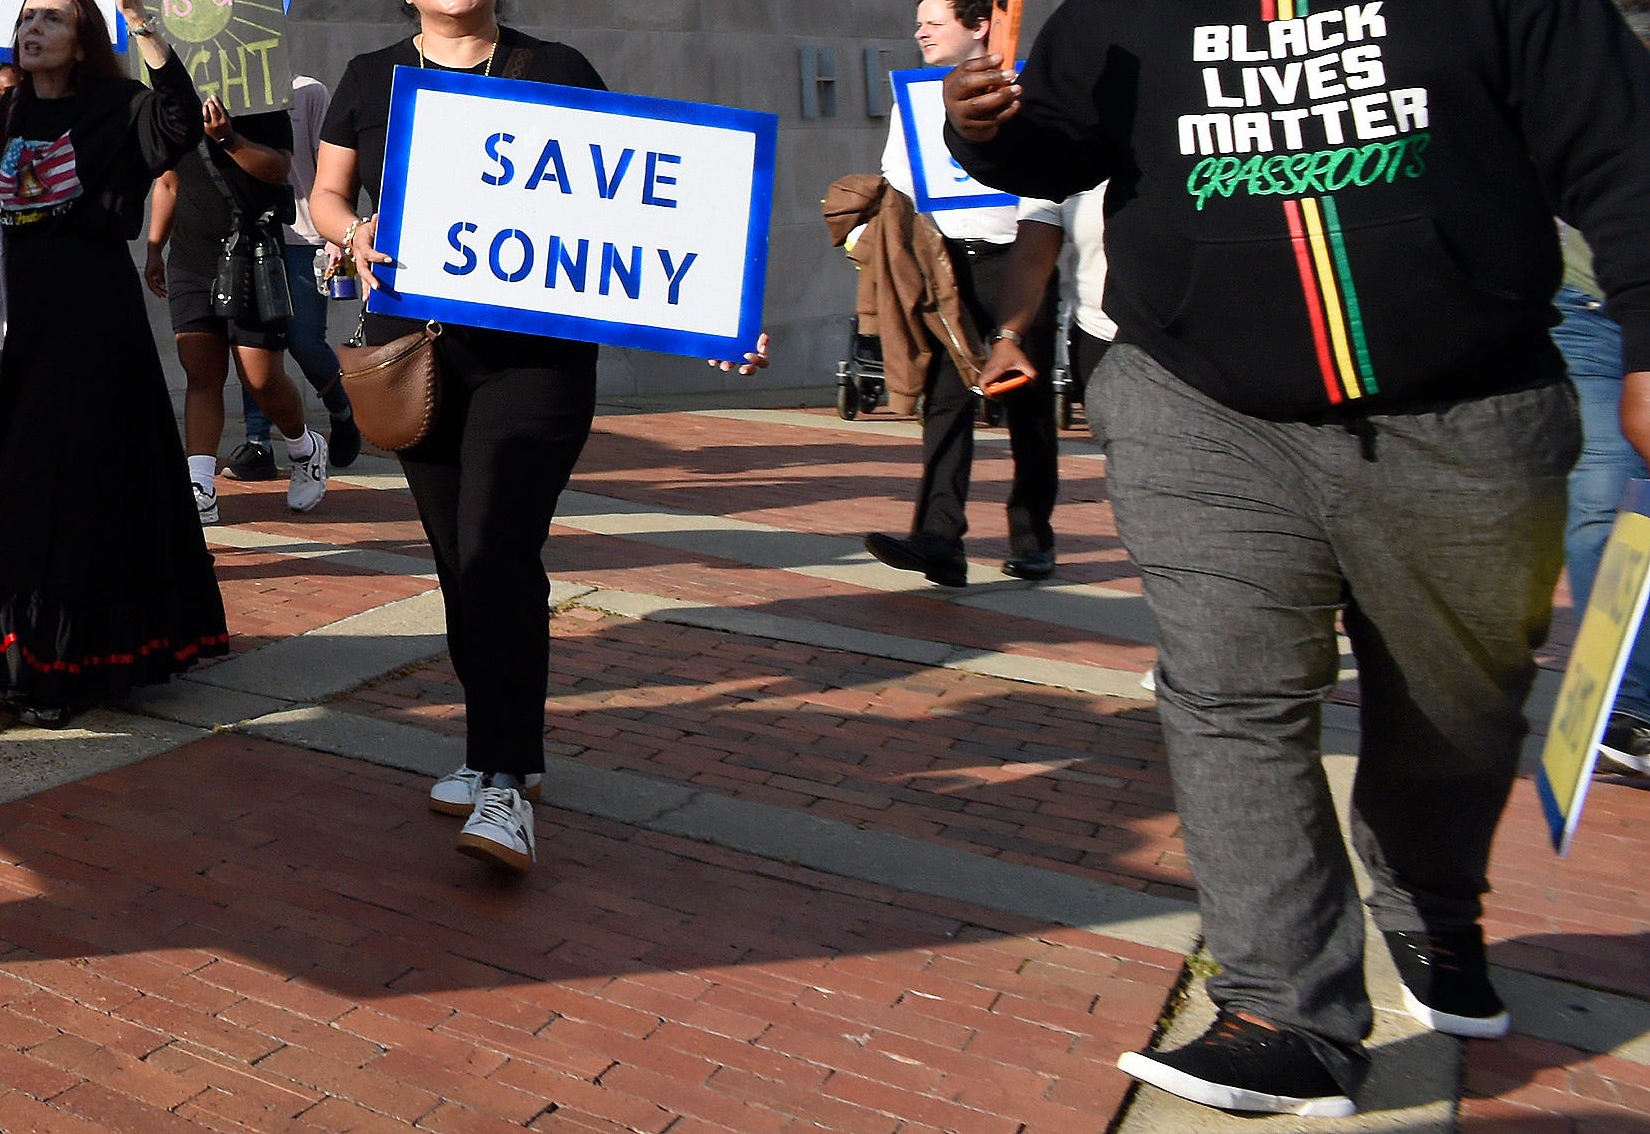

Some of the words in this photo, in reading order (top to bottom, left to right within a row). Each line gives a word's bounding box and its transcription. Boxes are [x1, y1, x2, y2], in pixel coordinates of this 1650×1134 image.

[1192, 0, 1387, 63] BLACK
[1202, 44, 1387, 108] LIVES
[1177, 87, 1430, 157] MATTER
[481, 132, 683, 209] SAVE
[1186, 132, 1431, 212] GRASSROOTS
[443, 221, 698, 305] SONNY
